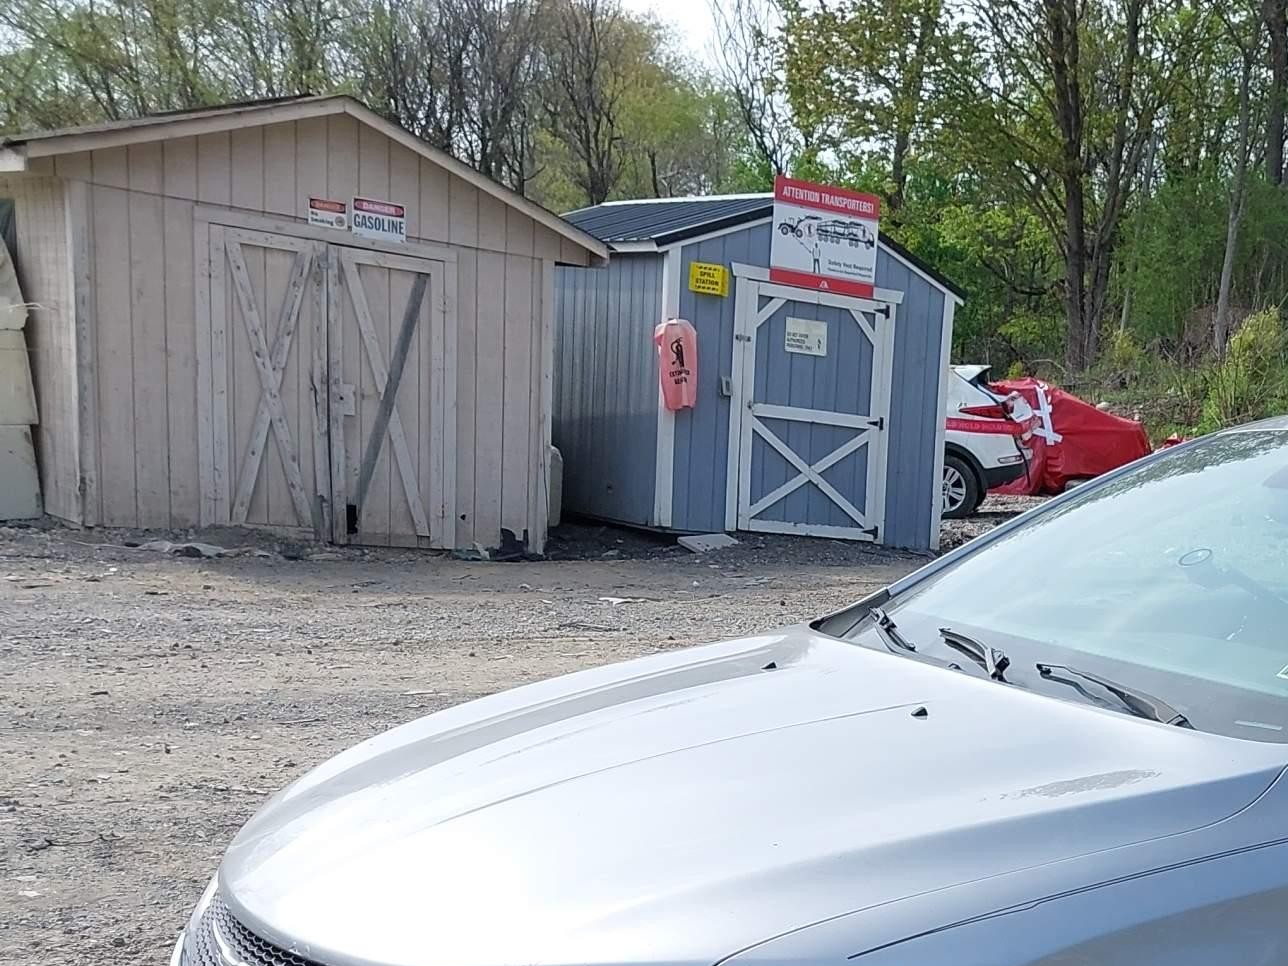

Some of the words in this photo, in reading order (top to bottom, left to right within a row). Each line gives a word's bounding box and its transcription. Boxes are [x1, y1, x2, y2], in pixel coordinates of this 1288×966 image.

[782, 186, 820, 203] ATTENTION
[821, 193, 874, 214] TRANSPORTERS!
[363, 202, 396, 215] DANGER
[311, 217, 334, 227] Smoking
[353, 213, 405, 236] GASOLINE
[700, 271, 715, 279] SPILL
[695, 278, 720, 286] STATION
